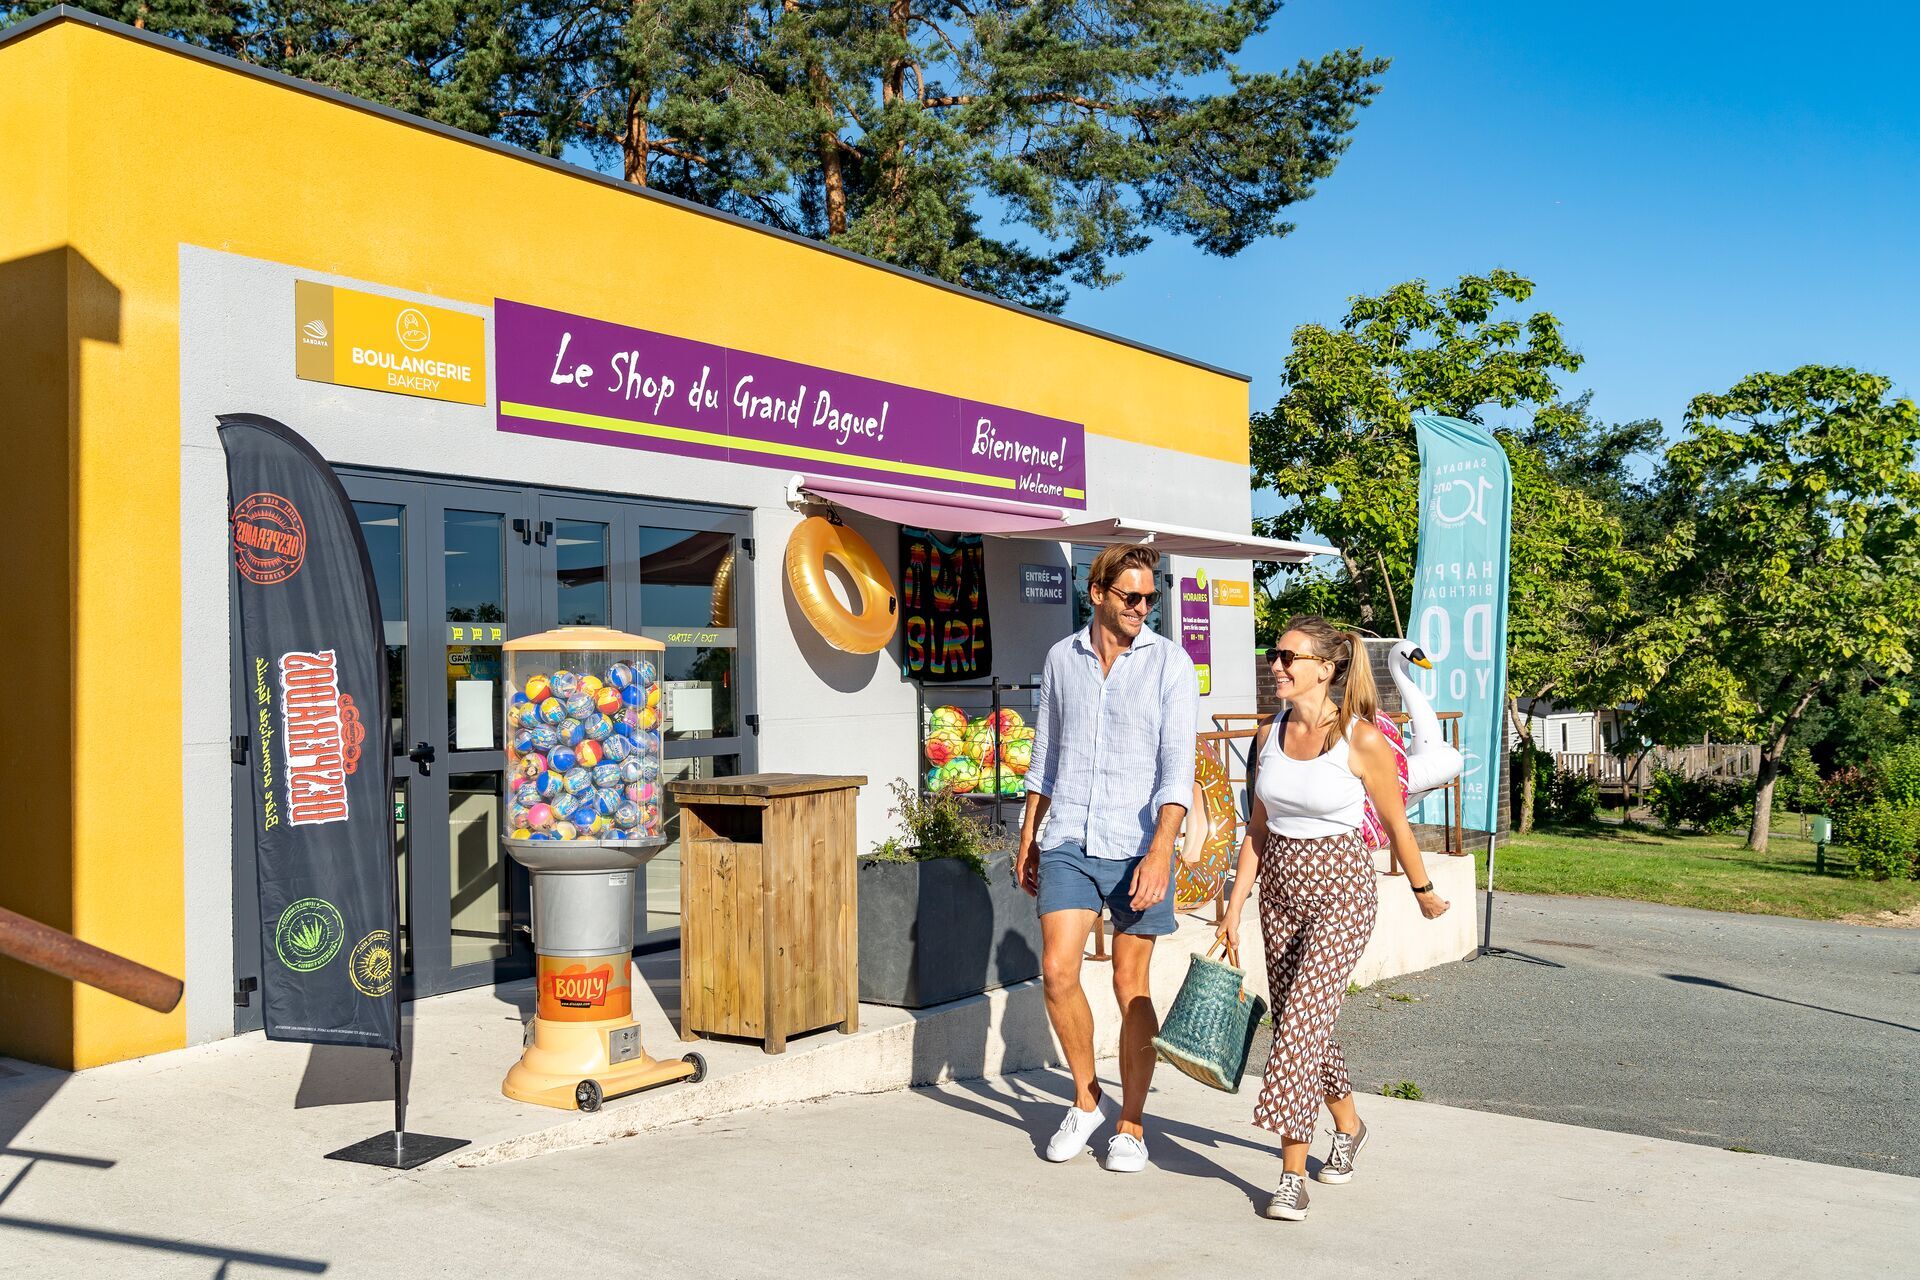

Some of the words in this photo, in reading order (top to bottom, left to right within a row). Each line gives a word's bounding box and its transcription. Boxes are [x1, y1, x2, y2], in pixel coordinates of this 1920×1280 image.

[302, 338, 328, 347] SANDAYA
[351, 346, 472, 382] BOULANGERIE
[387, 371, 441, 393] BAKERY
[549, 331, 594, 388] Le
[607, 350, 676, 416] Shop
[688, 365, 718, 412] du
[733, 374, 806, 430] Grand
[812, 388, 890, 447] Dague!
[971, 416, 1067, 471] Bienvenue!
[1018, 473, 1064, 498] Welcome
[1025, 569, 1051, 582] ENTRÉE
[1025, 586, 1063, 599] ENTRANCE
[1183, 593, 1207, 602] HORAIRES
[667, 632, 693, 644] SORTIE
[700, 633, 719, 644] EXIT
[907, 616, 984, 673] SURF
[451, 654, 473, 662] GAME
[555, 976, 605, 1000] BOULY
